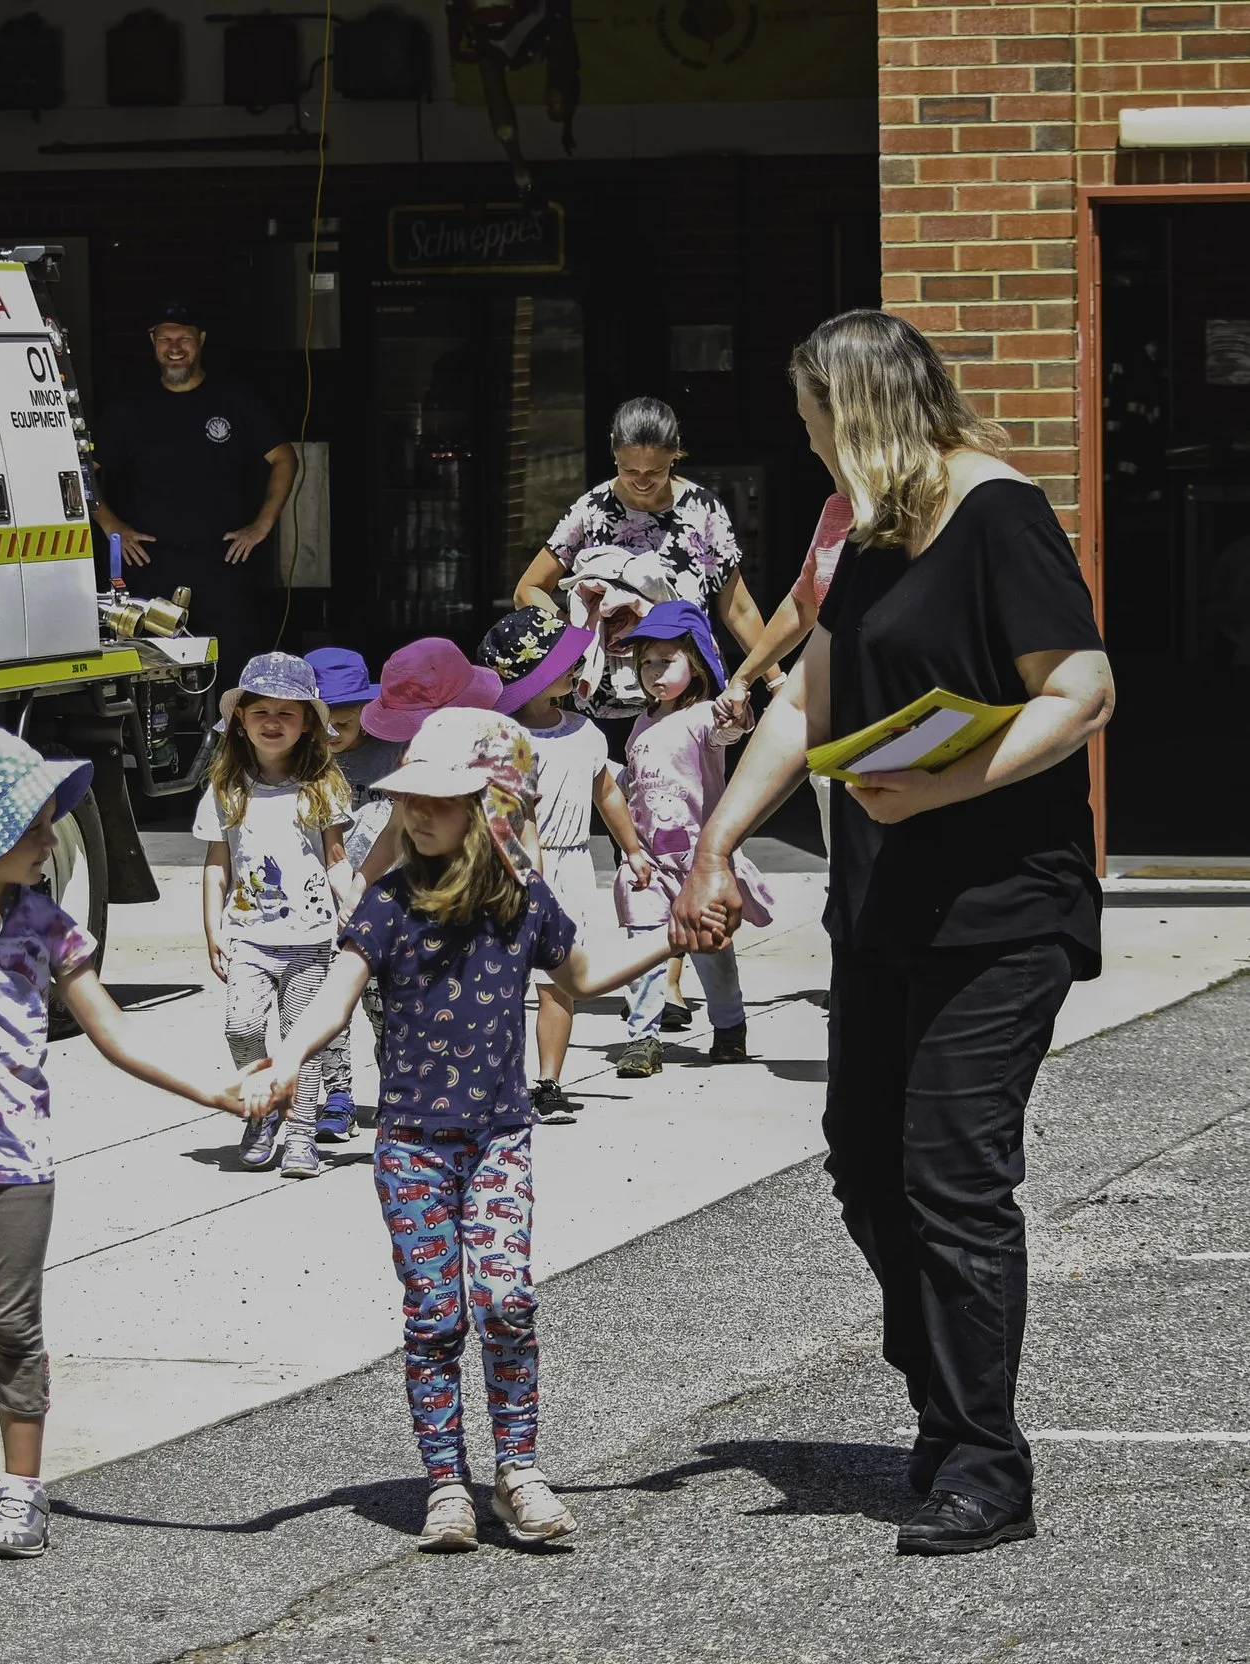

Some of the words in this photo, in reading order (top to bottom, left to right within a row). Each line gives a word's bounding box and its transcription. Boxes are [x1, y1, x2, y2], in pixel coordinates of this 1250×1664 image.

[407, 209, 543, 262] Schweppes
[26, 346, 56, 383] 01
[29, 389, 63, 406] MINOR
[10, 411, 67, 428] EQUIPMENT
[641, 765, 660, 779] best
